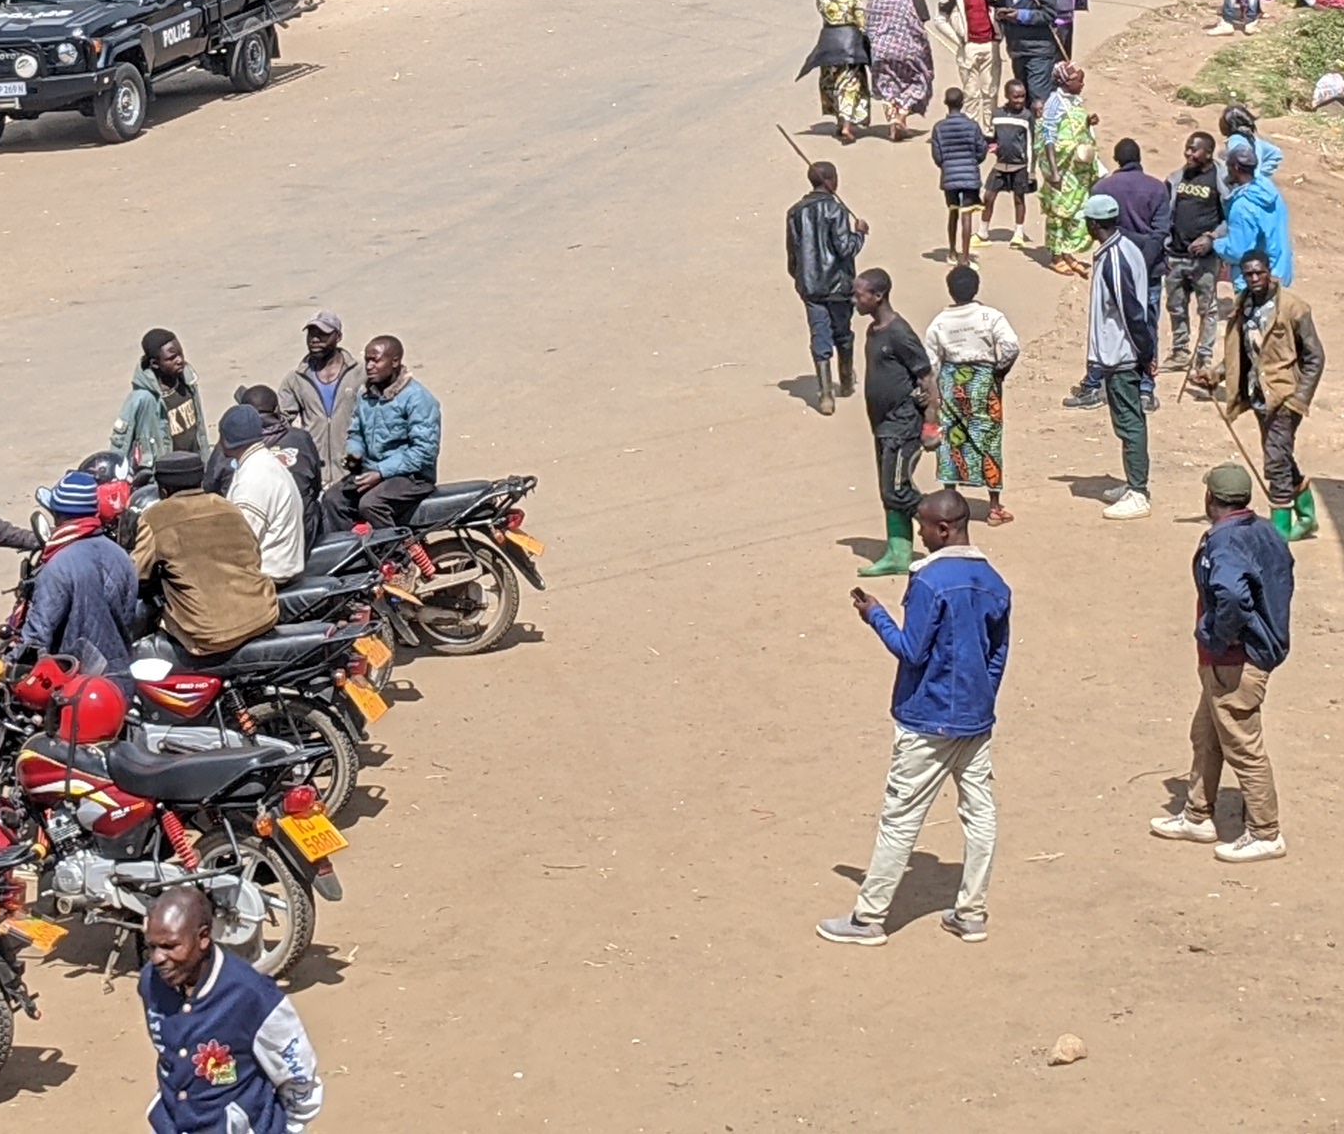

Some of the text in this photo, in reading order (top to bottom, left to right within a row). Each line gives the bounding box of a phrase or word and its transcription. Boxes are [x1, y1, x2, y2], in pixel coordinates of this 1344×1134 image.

[162, 20, 191, 48] POLICE
[1176, 182, 1211, 199] BOSS
[302, 830, 341, 856] 588D
